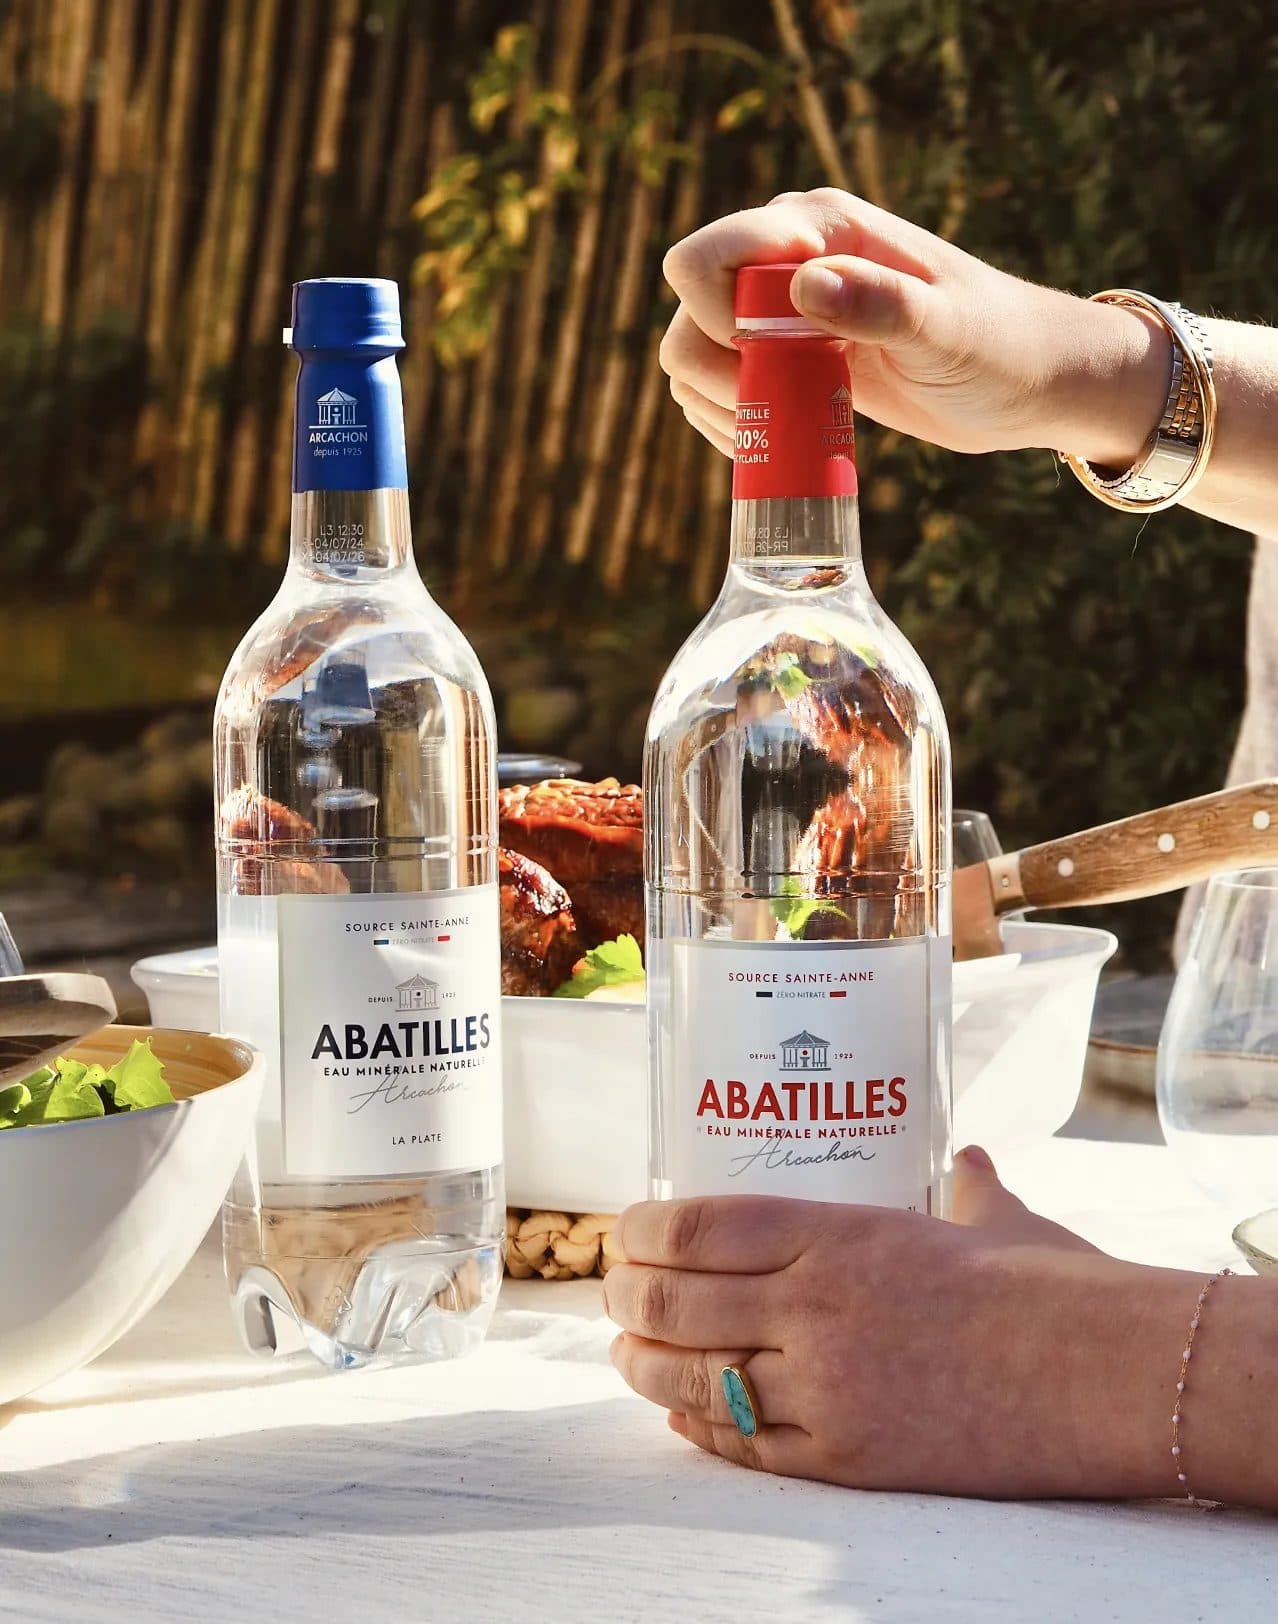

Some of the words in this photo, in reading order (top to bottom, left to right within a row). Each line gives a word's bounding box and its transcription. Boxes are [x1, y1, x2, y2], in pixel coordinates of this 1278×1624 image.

[308, 431, 368, 443] ARCACHON
[313, 446, 340, 459] depuis
[343, 447, 362, 456] 1925
[320, 524, 334, 536] L3
[337, 523, 364, 536] 12:30
[345, 922, 394, 932] SOURCE
[400, 916, 470, 930] SAINTE-ANNE
[728, 972, 778, 983] SOURCE
[785, 971, 874, 983] SAINTE-ANNE
[311, 1013, 490, 1060] ABATILLES
[324, 1067, 350, 1077] EAU
[356, 1062, 425, 1077] MINÉRALE
[430, 1056, 485, 1073] NATURELLE
[696, 1076, 908, 1121] ABATILLES
[392, 1136, 405, 1145] LA
[411, 1133, 442, 1144] PLATE
[707, 1125, 731, 1137] EAU
[737, 1126, 811, 1139] MINÉRALE
[818, 1124, 897, 1138] NATURELLE
[728, 1130, 876, 1177] Arcachon
